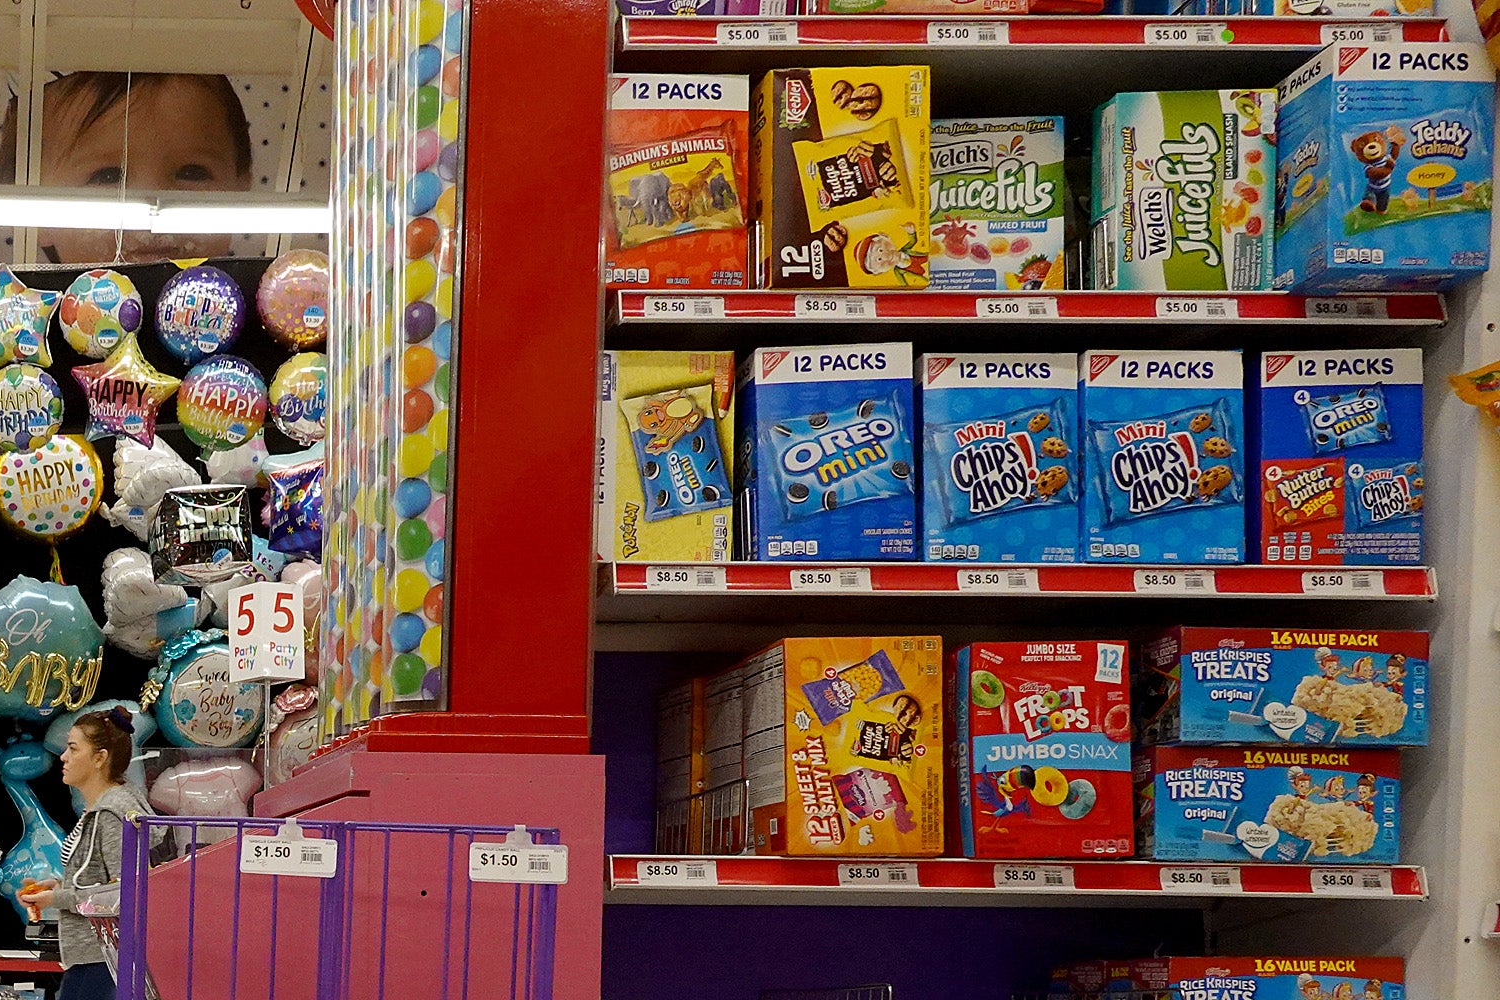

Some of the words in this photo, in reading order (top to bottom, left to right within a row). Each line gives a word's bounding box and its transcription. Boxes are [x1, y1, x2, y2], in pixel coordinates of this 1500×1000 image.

[632, 6, 655, 16] Berry
[728, 29, 759, 40] $5.00
[937, 28, 969, 39] $5.00
[1155, 29, 1187, 40] $5.00
[1332, 30, 1363, 41] $5.00
[1373, 53, 1391, 70] 12
[1400, 53, 1469, 71] PACKS
[632, 83, 648, 100] 12
[658, 84, 722, 100] PACKS
[1411, 120, 1471, 144] Teddy
[929, 158, 1054, 217] Juicefuls
[1156, 122, 1221, 267] Juicefuls
[1021, 221, 1046, 229] FRUIT
[1147, 191, 1166, 256] Welch's
[781, 246, 810, 277] 12
[654, 301, 685, 312] $8.50
[806, 301, 837, 312] $8.50
[987, 303, 1018, 314] $5.00
[1166, 303, 1197, 313] $5.00
[1316, 303, 1348, 314] $8.50
[794, 356, 811, 372] 12
[820, 353, 886, 371] PACKS
[960, 363, 977, 378] 12
[984, 361, 1050, 379] PACKS
[1121, 363, 1138, 378] 12
[1149, 361, 1214, 379] PACKS
[1299, 360, 1315, 376] 12
[1325, 358, 1394, 376] PACKS
[90, 376, 149, 411] HAPPY
[1314, 399, 1378, 428] OREO
[1334, 411, 1374, 435] mini
[954, 420, 1005, 447] Mini
[1114, 420, 1166, 447] Mini
[783, 419, 895, 475] OREO
[817, 441, 888, 483] mini
[16, 458, 76, 494] HAPPY
[657, 572, 688, 583] $8.50
[800, 573, 831, 585] $8.50
[967, 574, 999, 585] $8.50
[1144, 575, 1176, 586] $8.50
[1312, 576, 1343, 587] $8.50
[237, 593, 255, 636] 5
[273, 593, 294, 633] 5
[1271, 631, 1293, 645] 16
[1293, 633, 1336, 646] VALUE
[1339, 633, 1378, 647] PACK
[234, 644, 258, 658] Party
[269, 641, 298, 656] Party
[1026, 644, 1055, 655] JUMBO
[1056, 644, 1076, 654] SIZE
[237, 658, 255, 670] City
[274, 655, 295, 670] City
[1100, 649, 1119, 670] 12
[1192, 652, 1218, 663] RICE
[1220, 649, 1272, 664] KRISPIES
[1193, 662, 1270, 681] TREATS
[986, 744, 1065, 762] JUMBO
[1068, 745, 1119, 760] SNAX
[1244, 751, 1265, 764] 16
[1266, 753, 1308, 765] VALUE
[1312, 753, 1349, 766] PACK
[1165, 771, 1192, 782] RICE
[1193, 768, 1245, 783] KRISPIES
[1167, 781, 1244, 800] TREATS
[254, 846, 290, 858] $1.50
[480, 854, 518, 866] $1.50
[647, 865, 678, 877] $8.50
[848, 868, 879, 879] $8.50
[1005, 870, 1036, 882] $8.50
[1172, 873, 1202, 885] $8.50
[1322, 875, 1353, 886] $8.50
[1254, 959, 1275, 972] 16
[1275, 960, 1315, 972] VALUE
[1319, 959, 1356, 972] PACK
[1180, 981, 1205, 992] RICE
[1206, 979, 1256, 992] KRISPIES
